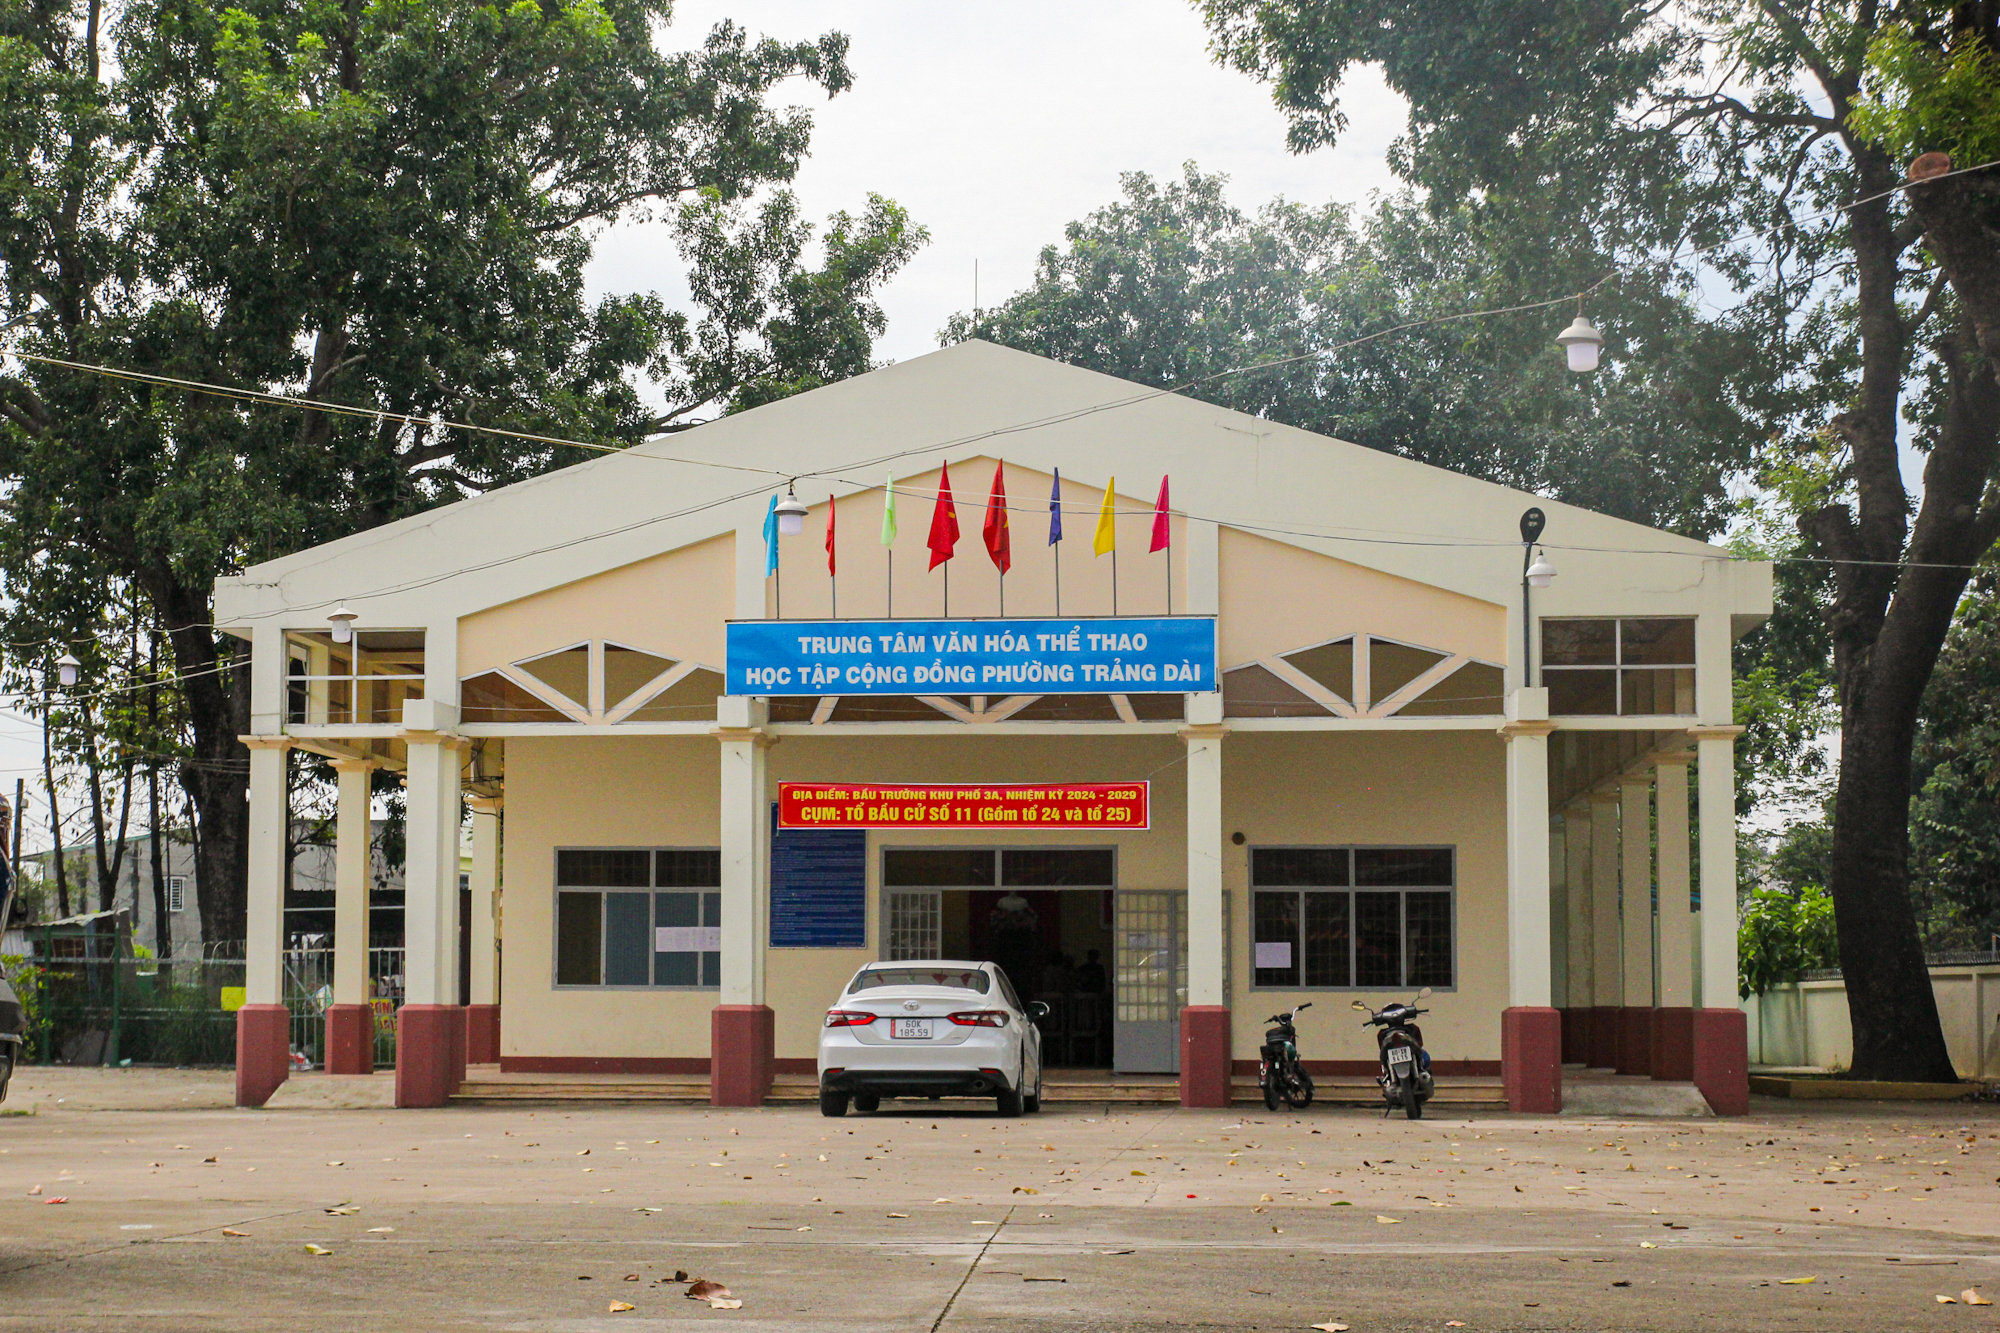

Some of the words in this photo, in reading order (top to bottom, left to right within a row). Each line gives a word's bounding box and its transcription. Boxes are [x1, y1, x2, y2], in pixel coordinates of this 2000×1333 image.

[798, 636, 872, 653] TRUNG
[879, 632, 925, 652] TÂM
[932, 631, 977, 652] VĂN
[985, 630, 1030, 652] HÓA
[1037, 625, 1080, 651] THỂ
[1087, 633, 1147, 651] THAO
[747, 667, 791, 689] HỌC
[798, 663, 840, 689] TẬP
[846, 663, 907, 688] CỘNG
[914, 659, 975, 683] ĐỒNG
[983, 660, 1074, 682] PHƯỜNG
[1081, 658, 1156, 681] TRẢNG
[1164, 659, 1200, 681] DÀI
[793, 791, 812, 801] ĐỊA
[930, 791, 953, 799] KHU
[957, 789, 980, 799] PHỐ
[1007, 790, 1045, 801] NHIỆM
[1049, 789, 1063, 799] KỲ
[1067, 791, 1096, 799] 2024
[1108, 791, 1136, 799] 2029
[802, 807, 840, 823] CỤM:
[845, 802, 864, 820] TỔ
[869, 803, 899, 820] BẦU
[904, 803, 926, 820] CỬ
[930, 803, 949, 820] SỐ
[955, 808, 970, 820] 11
[979, 806, 1017, 822] (Gồm
[1022, 805, 1037, 820] tổ
[1042, 808, 1060, 820] 24
[1065, 807, 1082, 820] và
[1087, 805, 1102, 820] tổ
[1107, 807, 1130, 821] 25)
[906, 1020, 921, 1028] 60K
[900, 1029, 928, 1037] 185.59
